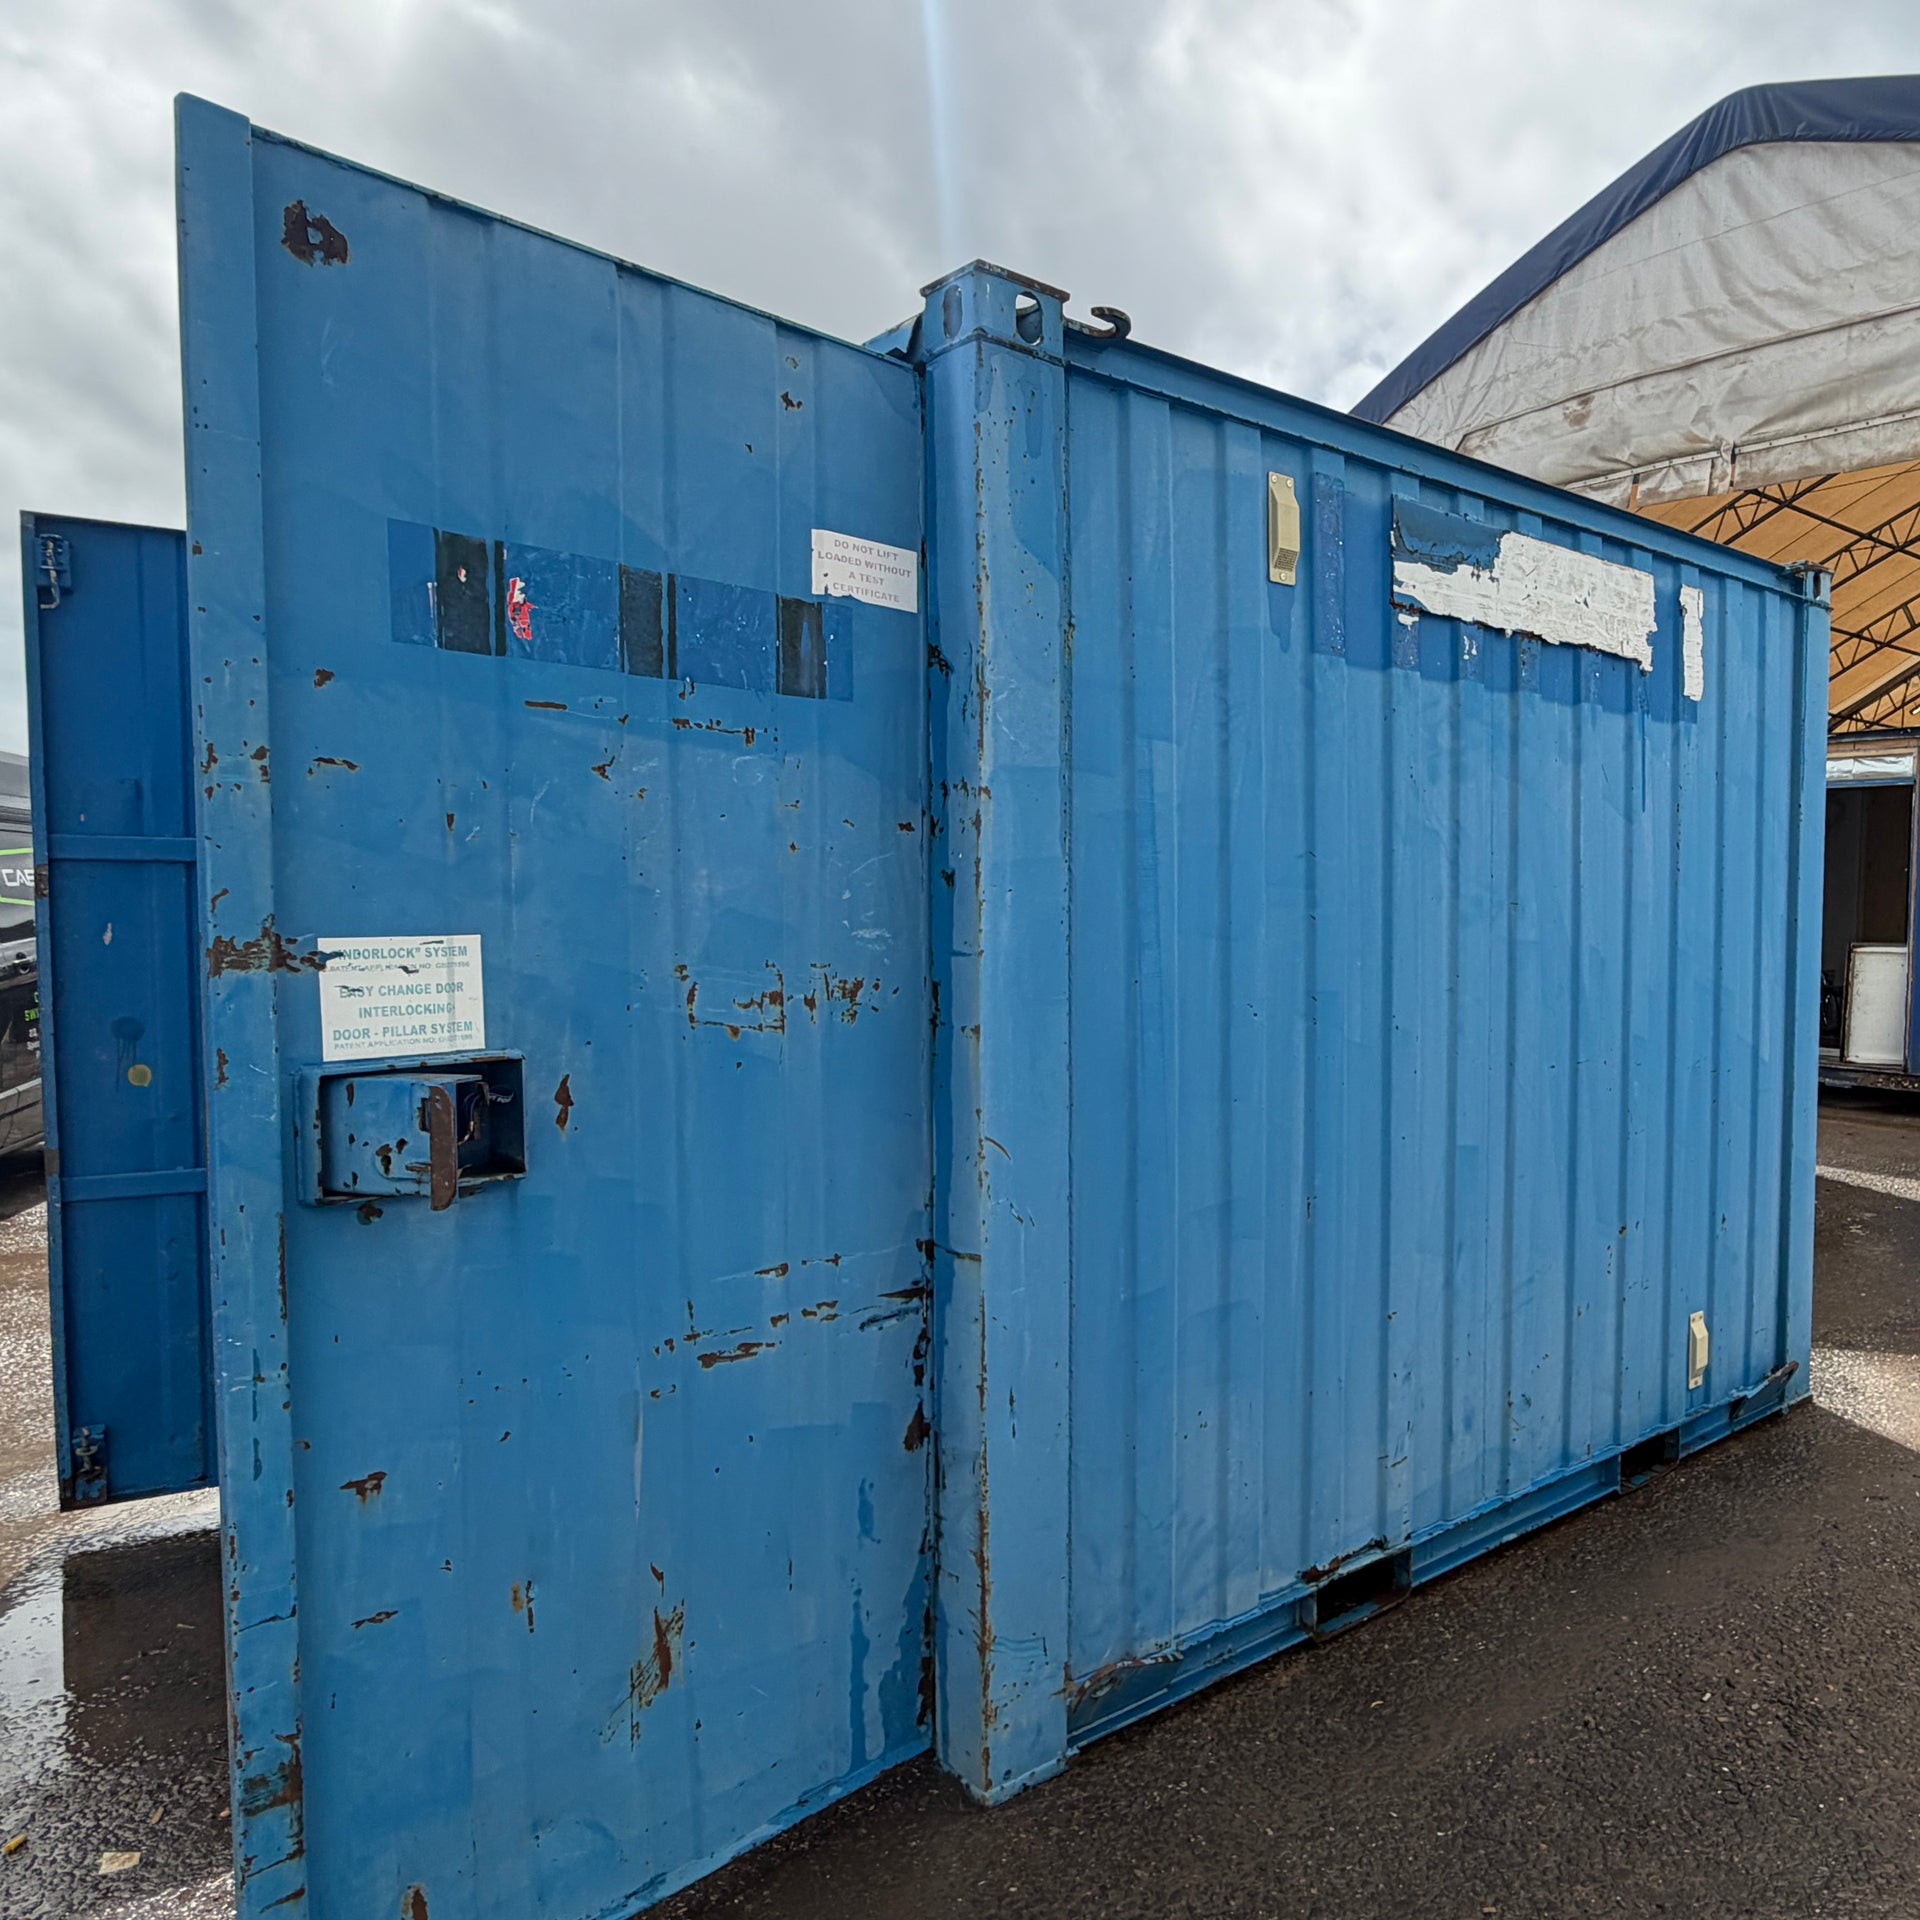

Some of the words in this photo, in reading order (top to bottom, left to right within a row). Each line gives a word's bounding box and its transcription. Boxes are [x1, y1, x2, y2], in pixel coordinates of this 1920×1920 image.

[834, 539, 849, 549] DO
[852, 543, 874, 555] NOT
[877, 549, 899, 561] LIFT
[817, 551, 862, 566] LOADED
[864, 561, 912, 578] WITHOUT
[848, 571, 856, 580] A
[859, 573, 885, 586] TEST
[833, 582, 900, 603] CERTIFICATE
[424, 945, 468, 958] SYSTEM
[339, 985, 374, 998] EASY
[378, 983, 431, 996] CHANGE
[436, 982, 464, 994] DOOR
[359, 1002, 455, 1018] INTERLOCKING
[333, 1027, 371, 1041] DOOR
[382, 1024, 427, 1038] PILLAR
[430, 1021, 473, 1034] SYSTEM
